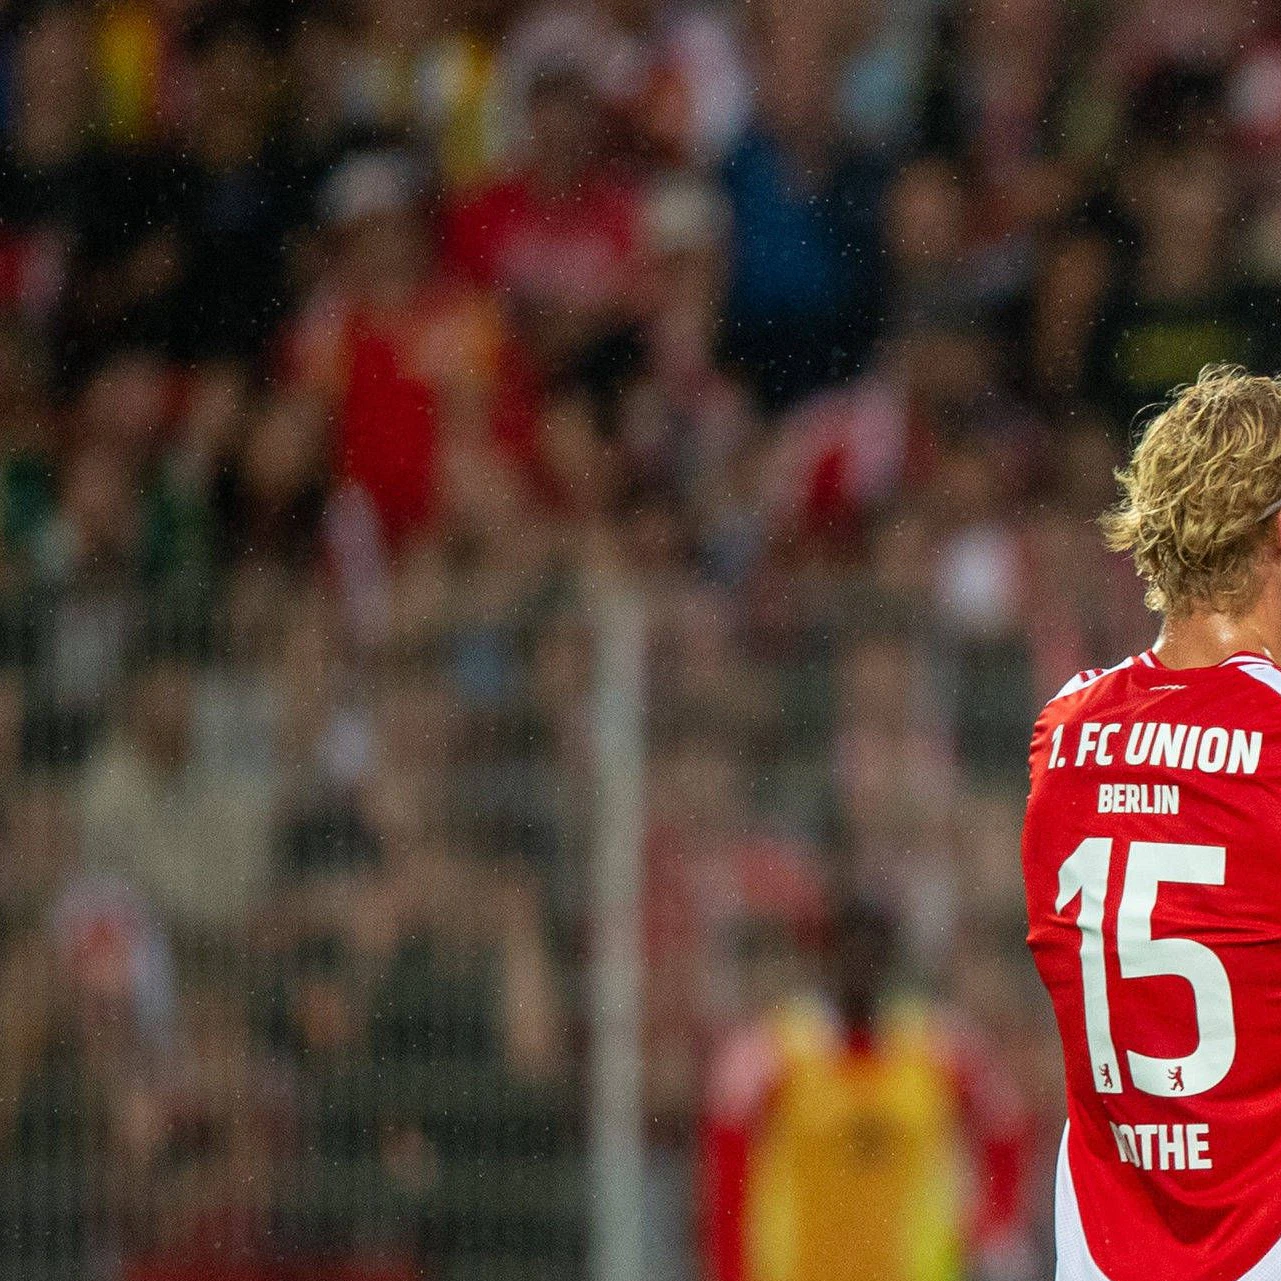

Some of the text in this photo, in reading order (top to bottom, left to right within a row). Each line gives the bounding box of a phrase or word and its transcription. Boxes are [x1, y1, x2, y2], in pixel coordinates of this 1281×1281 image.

[1048, 722, 1263, 775] 1. FC UNION
[1097, 783, 1180, 815] BERLIN
[1054, 837, 1237, 1098] 15
